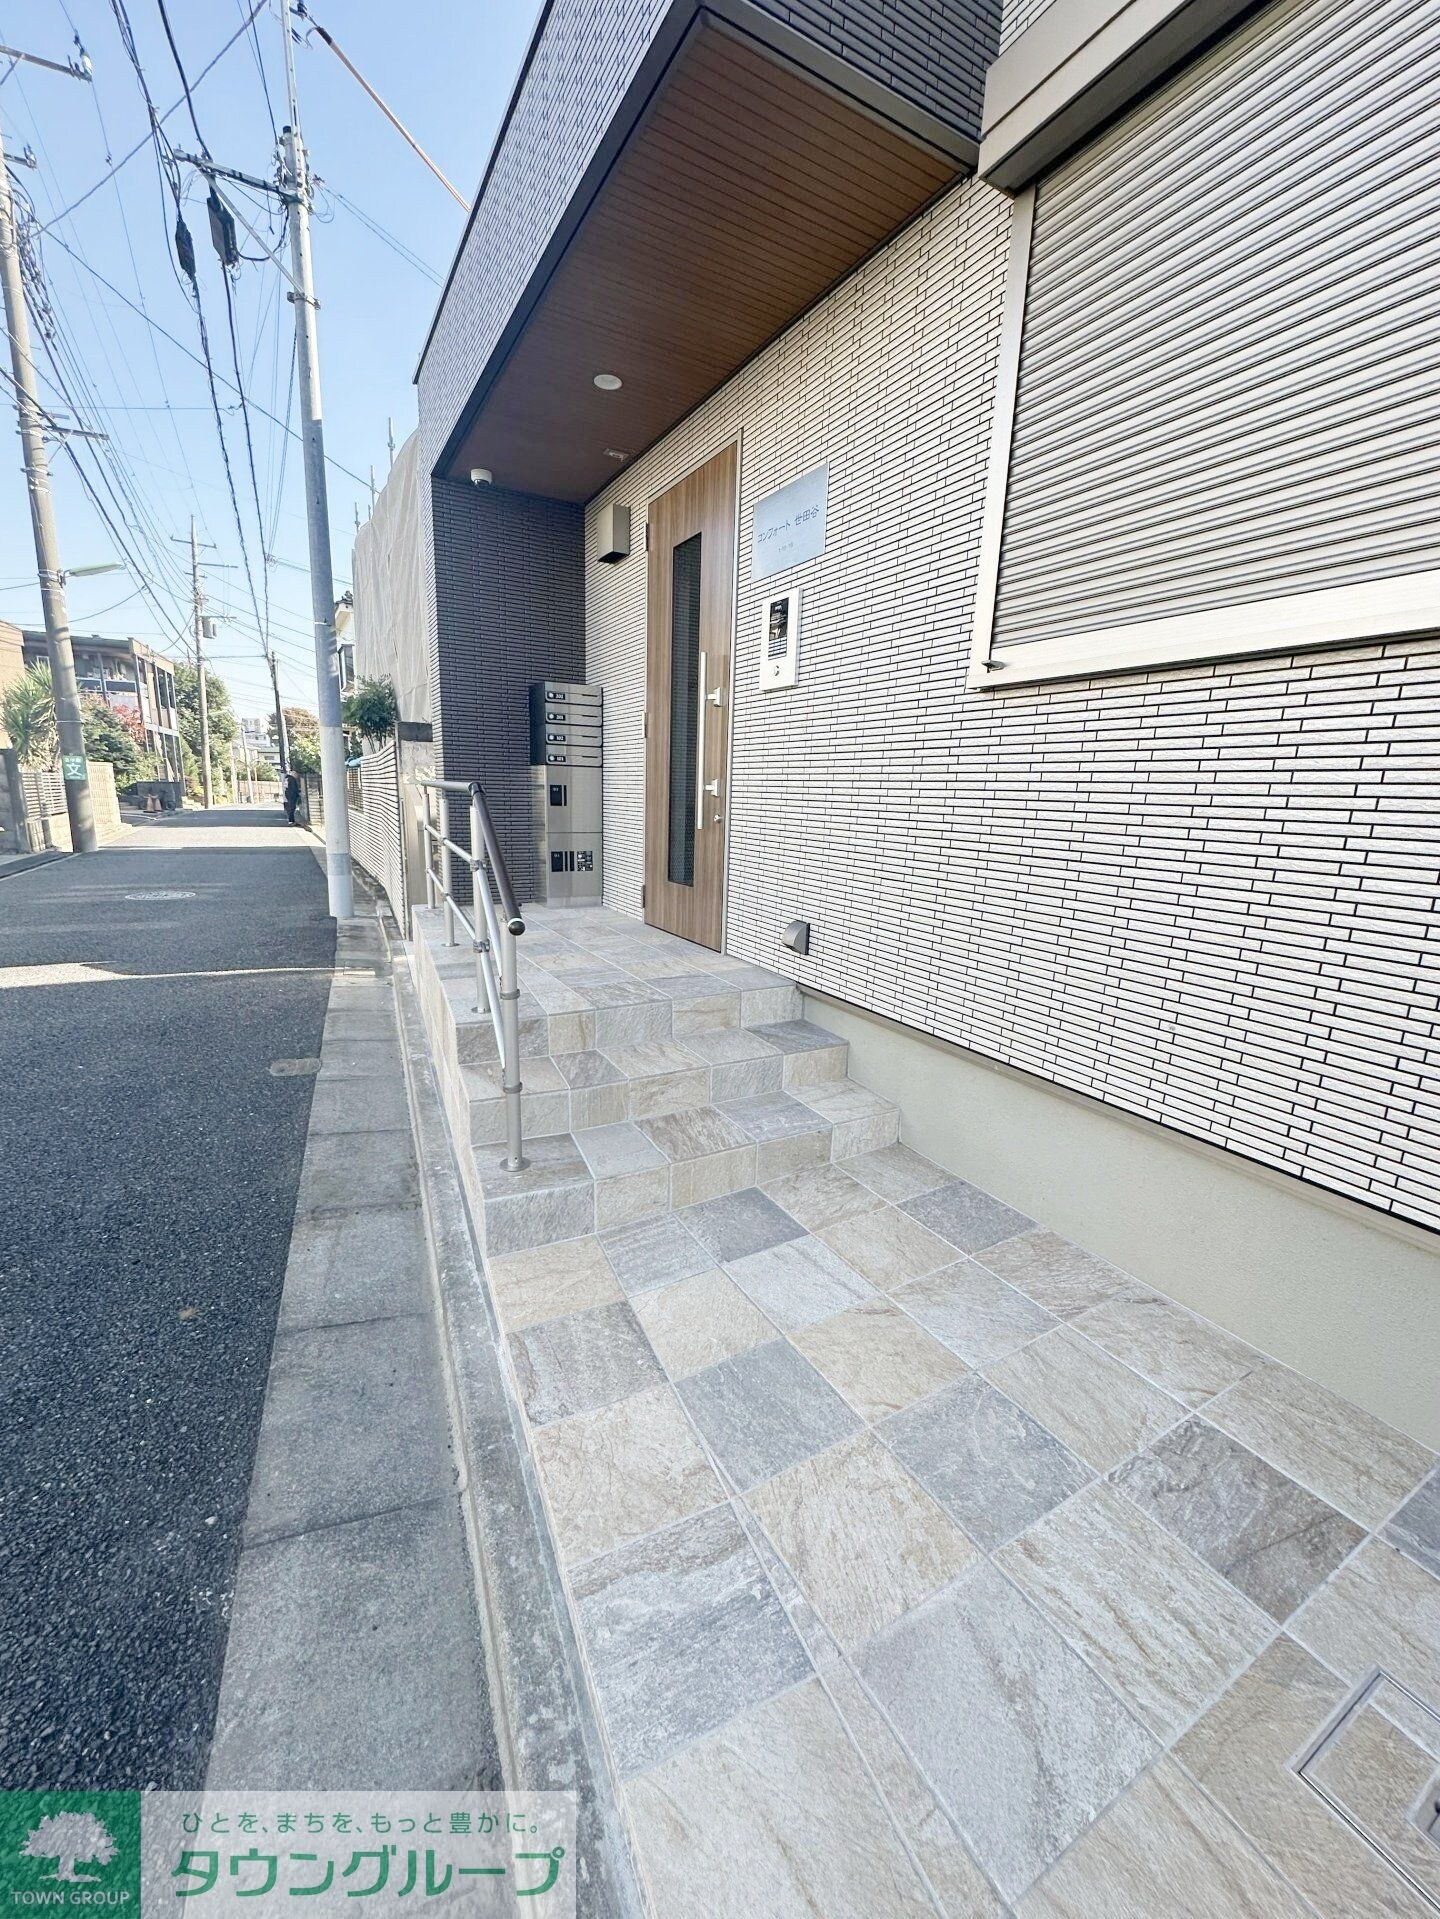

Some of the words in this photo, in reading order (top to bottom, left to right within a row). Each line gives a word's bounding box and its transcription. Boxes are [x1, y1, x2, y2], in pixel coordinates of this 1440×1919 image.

[757, 520, 790, 543] コンフォート
[794, 504, 819, 526] 世田谷
